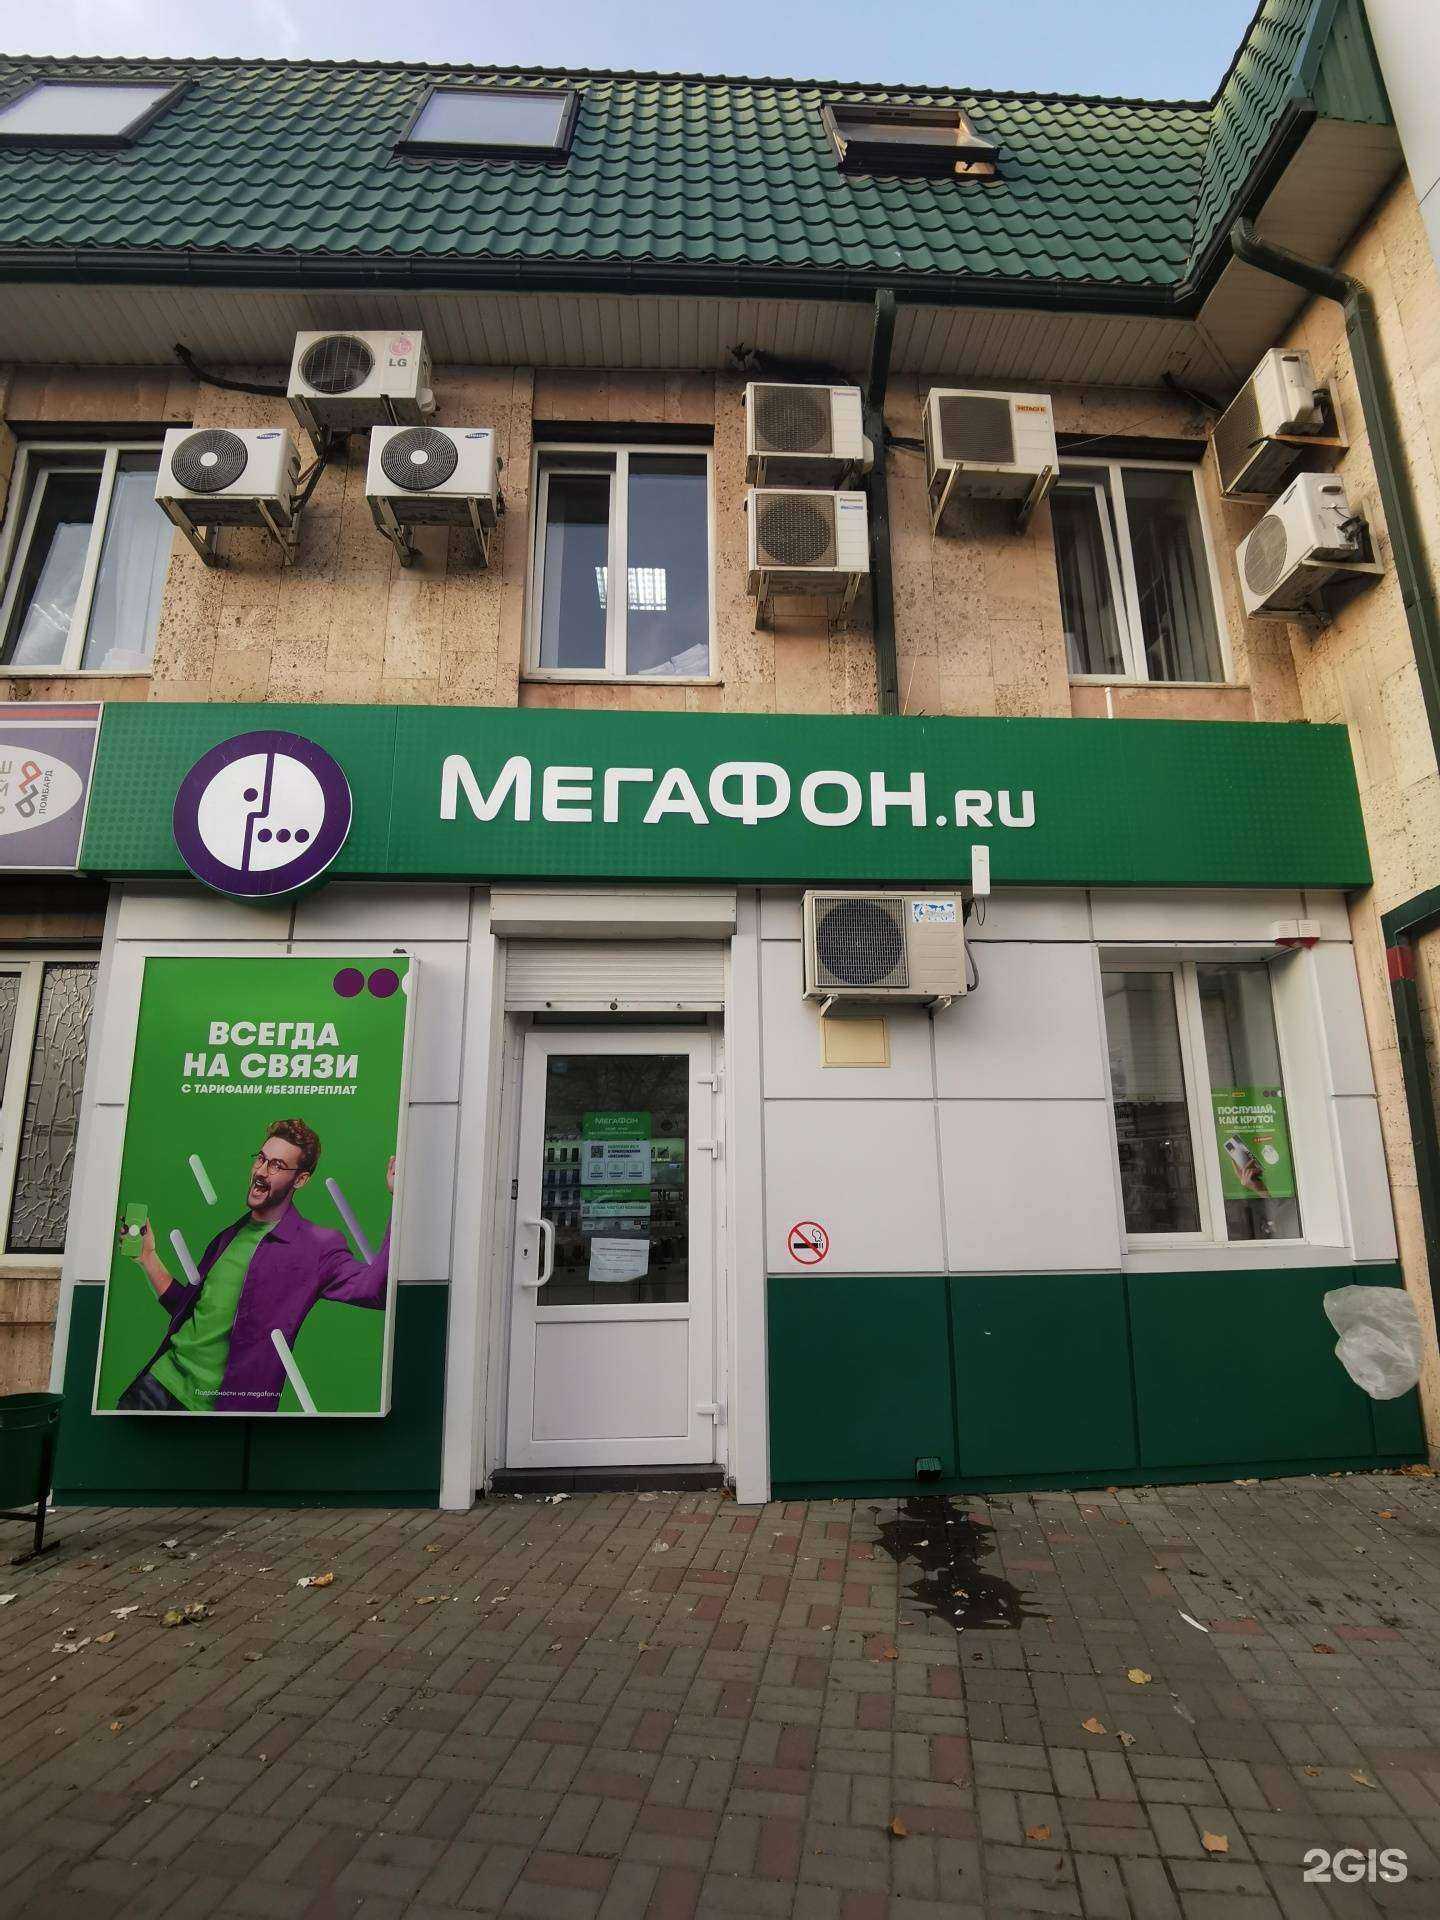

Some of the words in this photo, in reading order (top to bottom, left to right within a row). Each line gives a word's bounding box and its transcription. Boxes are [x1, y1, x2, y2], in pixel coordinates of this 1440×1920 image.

[388, 358, 407, 367] LG
[208, 1021, 340, 1050] ВСЕГДА
[183, 1052, 230, 1077] НА
[240, 1053, 359, 1079] СВЯЗИ
[181, 1083, 192, 1094] С
[195, 1084, 262, 1094] ТАРИФАМИ
[265, 1085, 358, 1096] #БЕЗПЕРЕПЛАТ
[1219, 1115, 1239, 1125] КАК
[195, 1388, 237, 1398] Подробности
[246, 1390, 283, 1399] megafon.ru
